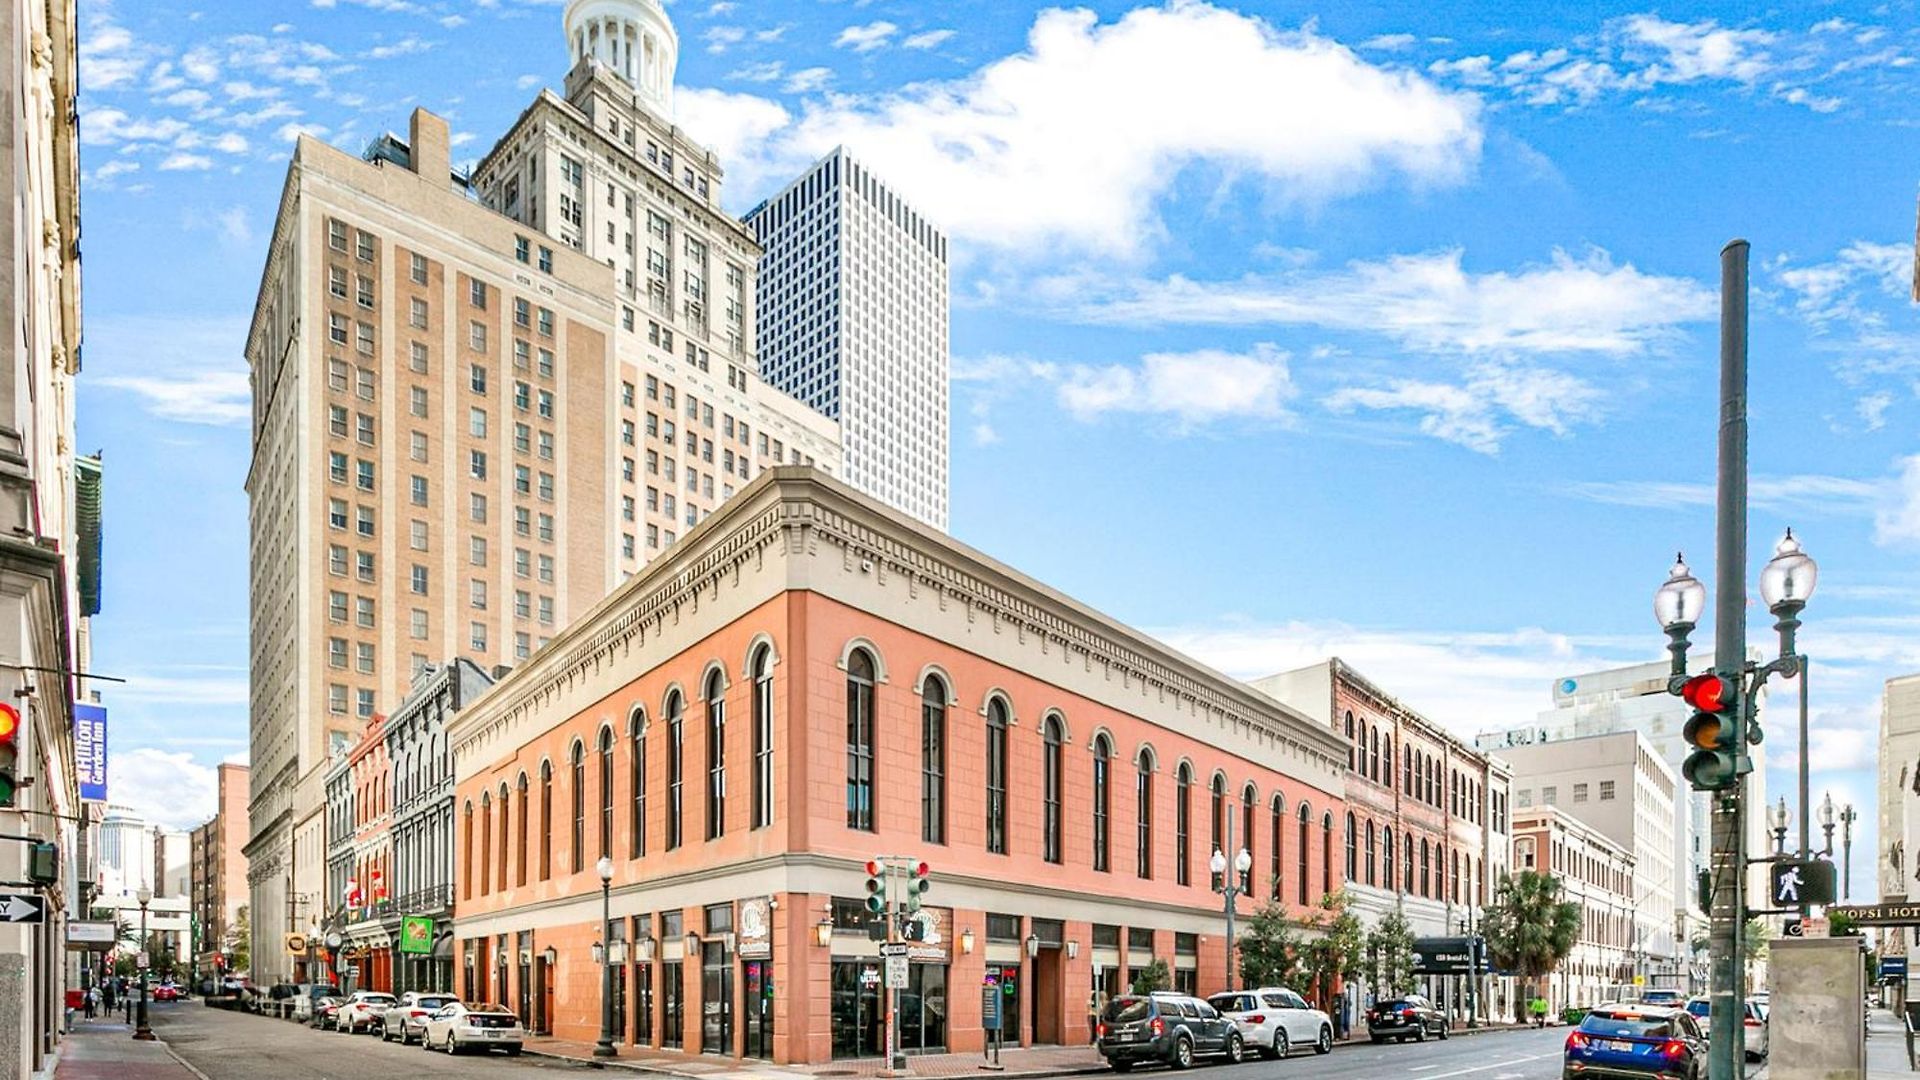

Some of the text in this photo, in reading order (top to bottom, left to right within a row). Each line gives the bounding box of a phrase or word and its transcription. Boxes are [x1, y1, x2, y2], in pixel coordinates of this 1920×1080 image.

[77, 720, 91, 771] Hilton
[92, 722, 104, 784] Garden Inn
[0, 902, 10, 912] Y
